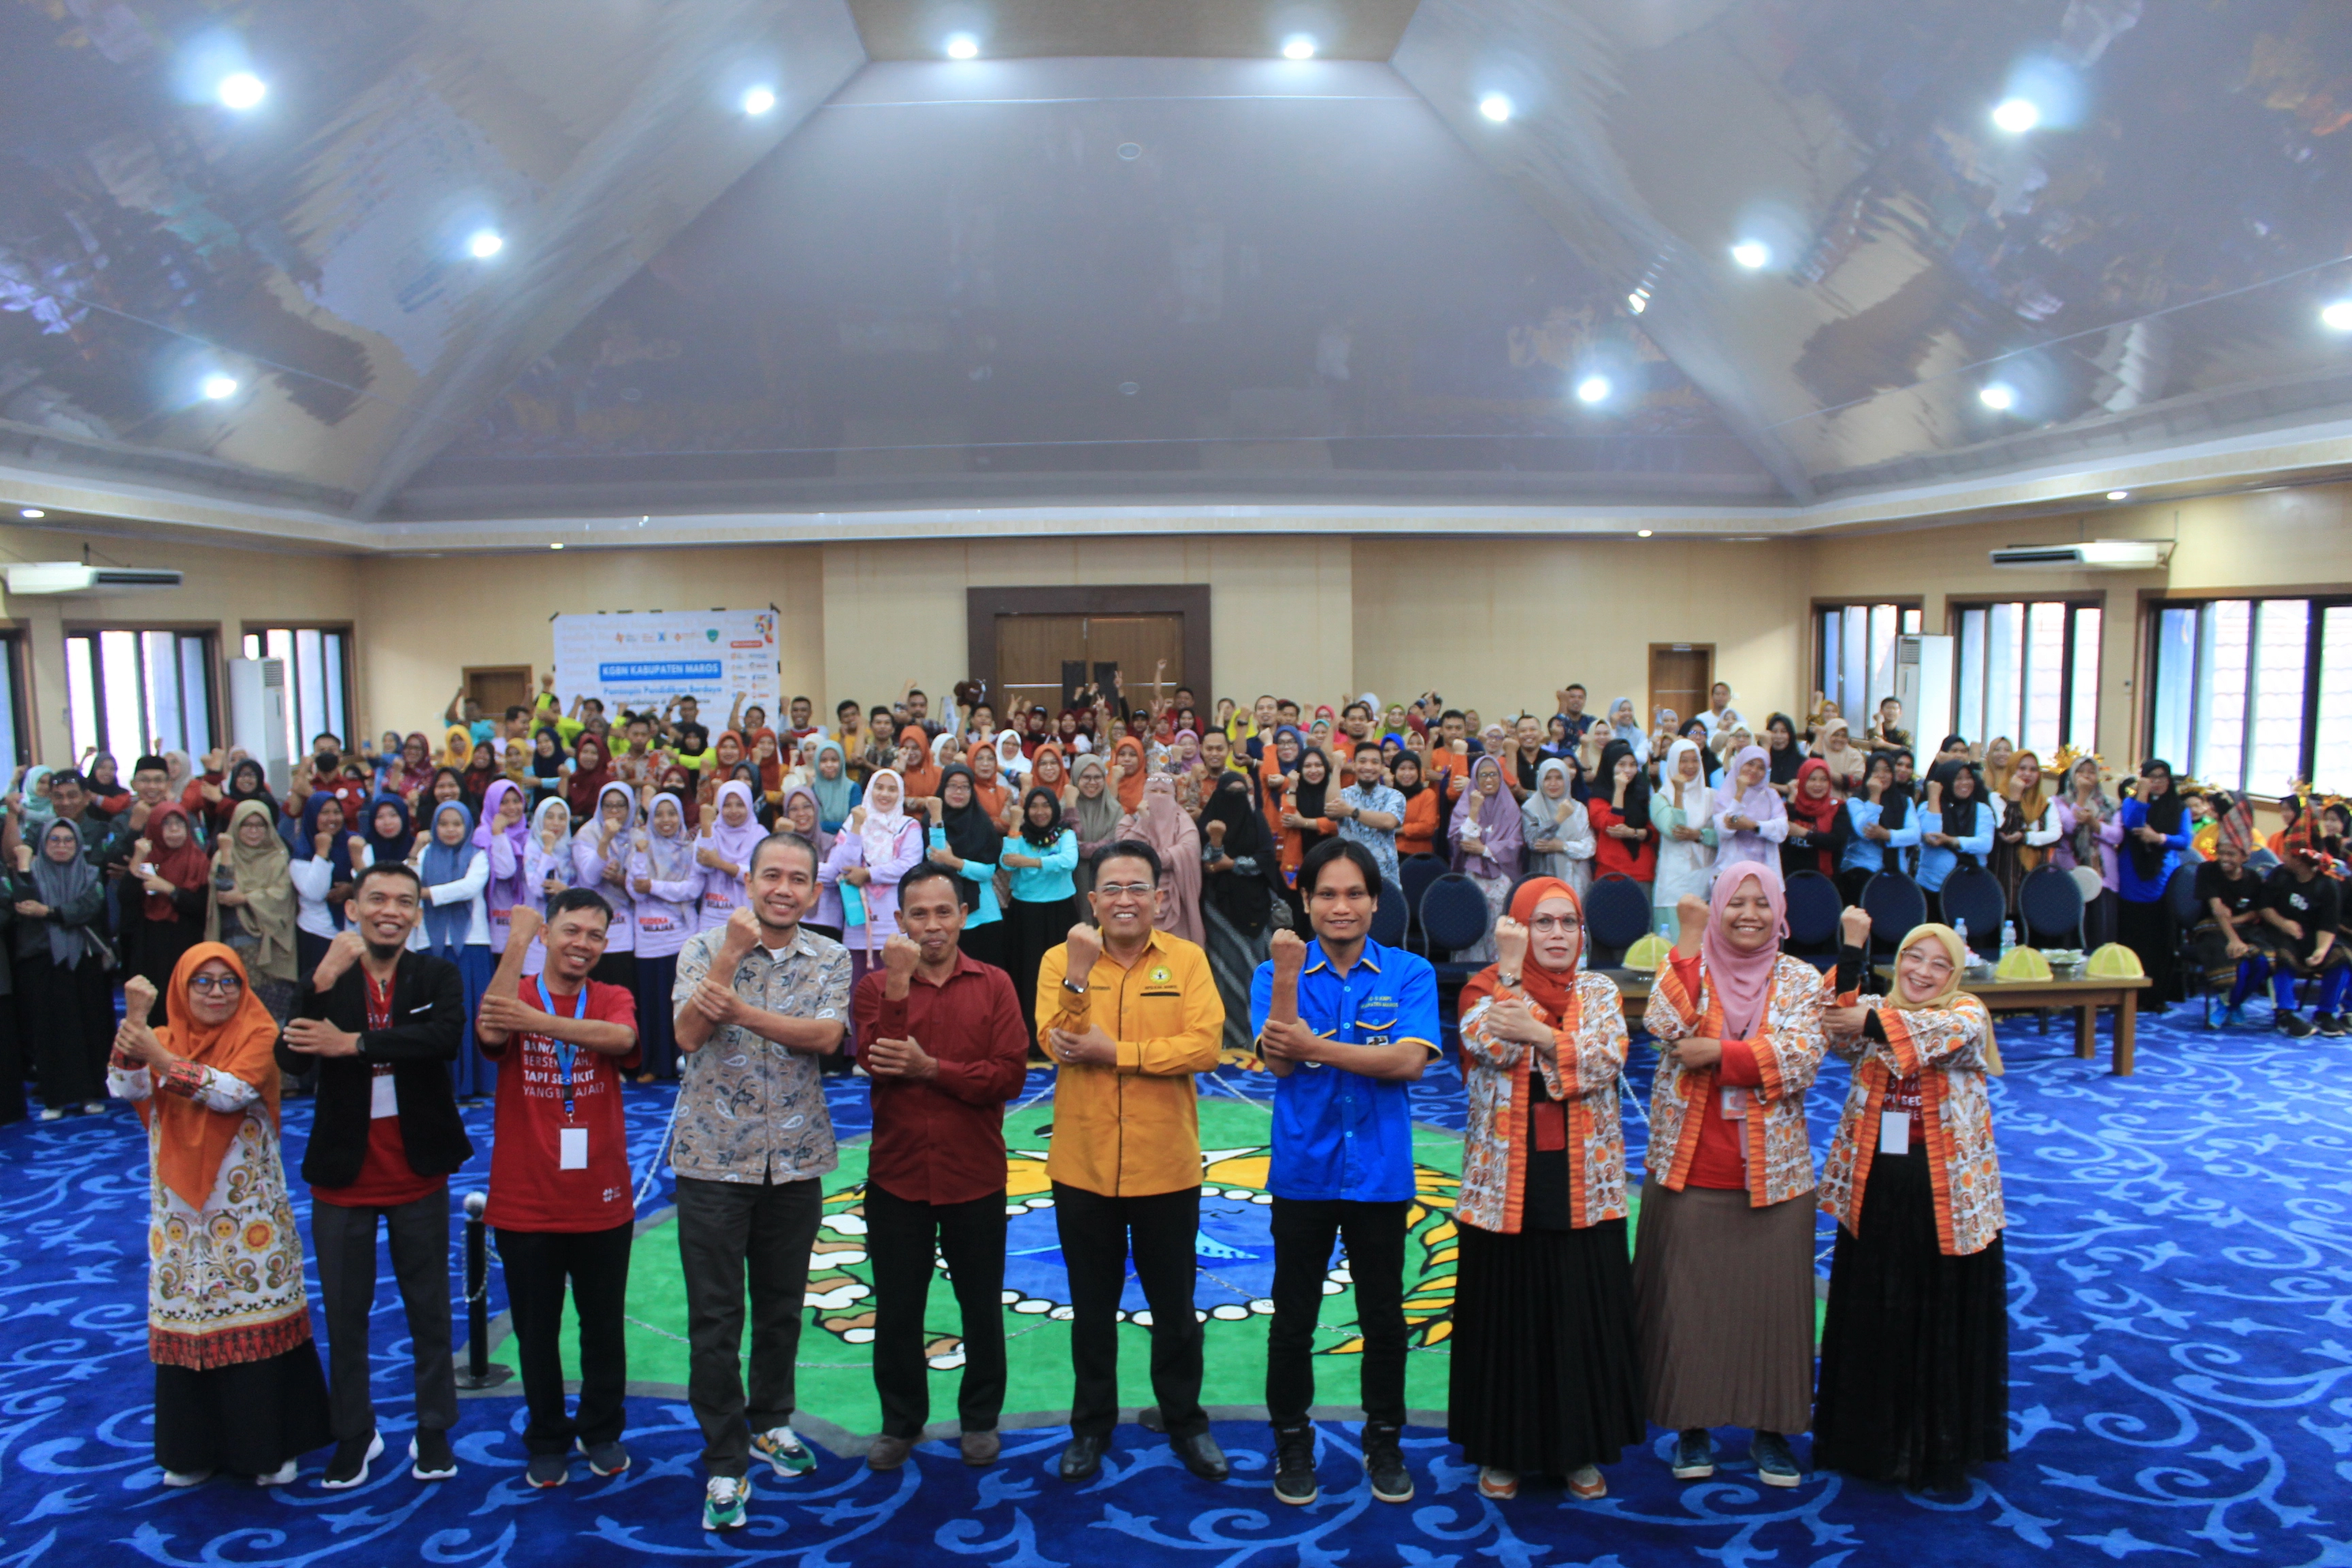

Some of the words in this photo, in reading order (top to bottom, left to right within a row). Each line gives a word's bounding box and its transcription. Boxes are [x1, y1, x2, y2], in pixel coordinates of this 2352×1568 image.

[630, 664, 684, 676] KABUPATEN
[685, 663, 719, 674] MAROS
[524, 1070, 549, 1083] TAPI
[551, 1068, 595, 1085] SEIKIT
[523, 1085, 555, 1098] YANG
